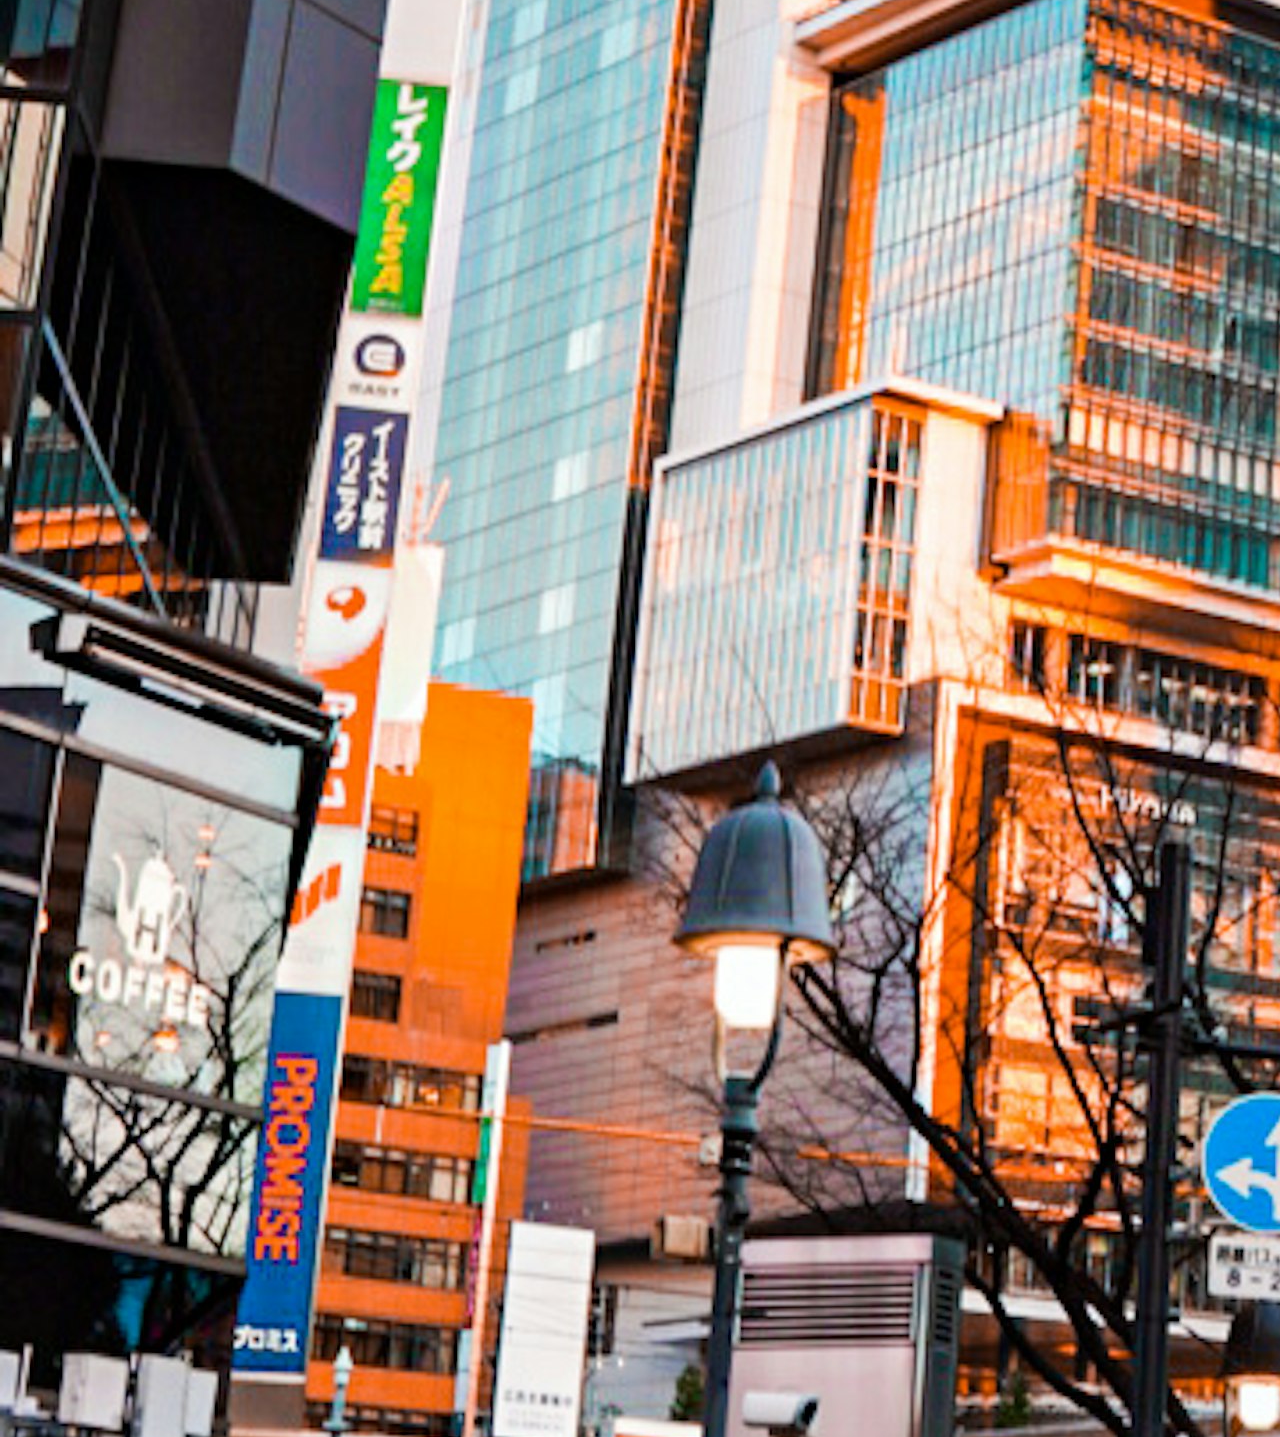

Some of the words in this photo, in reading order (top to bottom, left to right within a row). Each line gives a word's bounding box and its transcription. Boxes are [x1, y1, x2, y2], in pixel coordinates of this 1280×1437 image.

[68, 950, 213, 1027] COFFEE
[254, 1052, 319, 1266] PROMISE
[232, 1324, 300, 1354] プロミス
